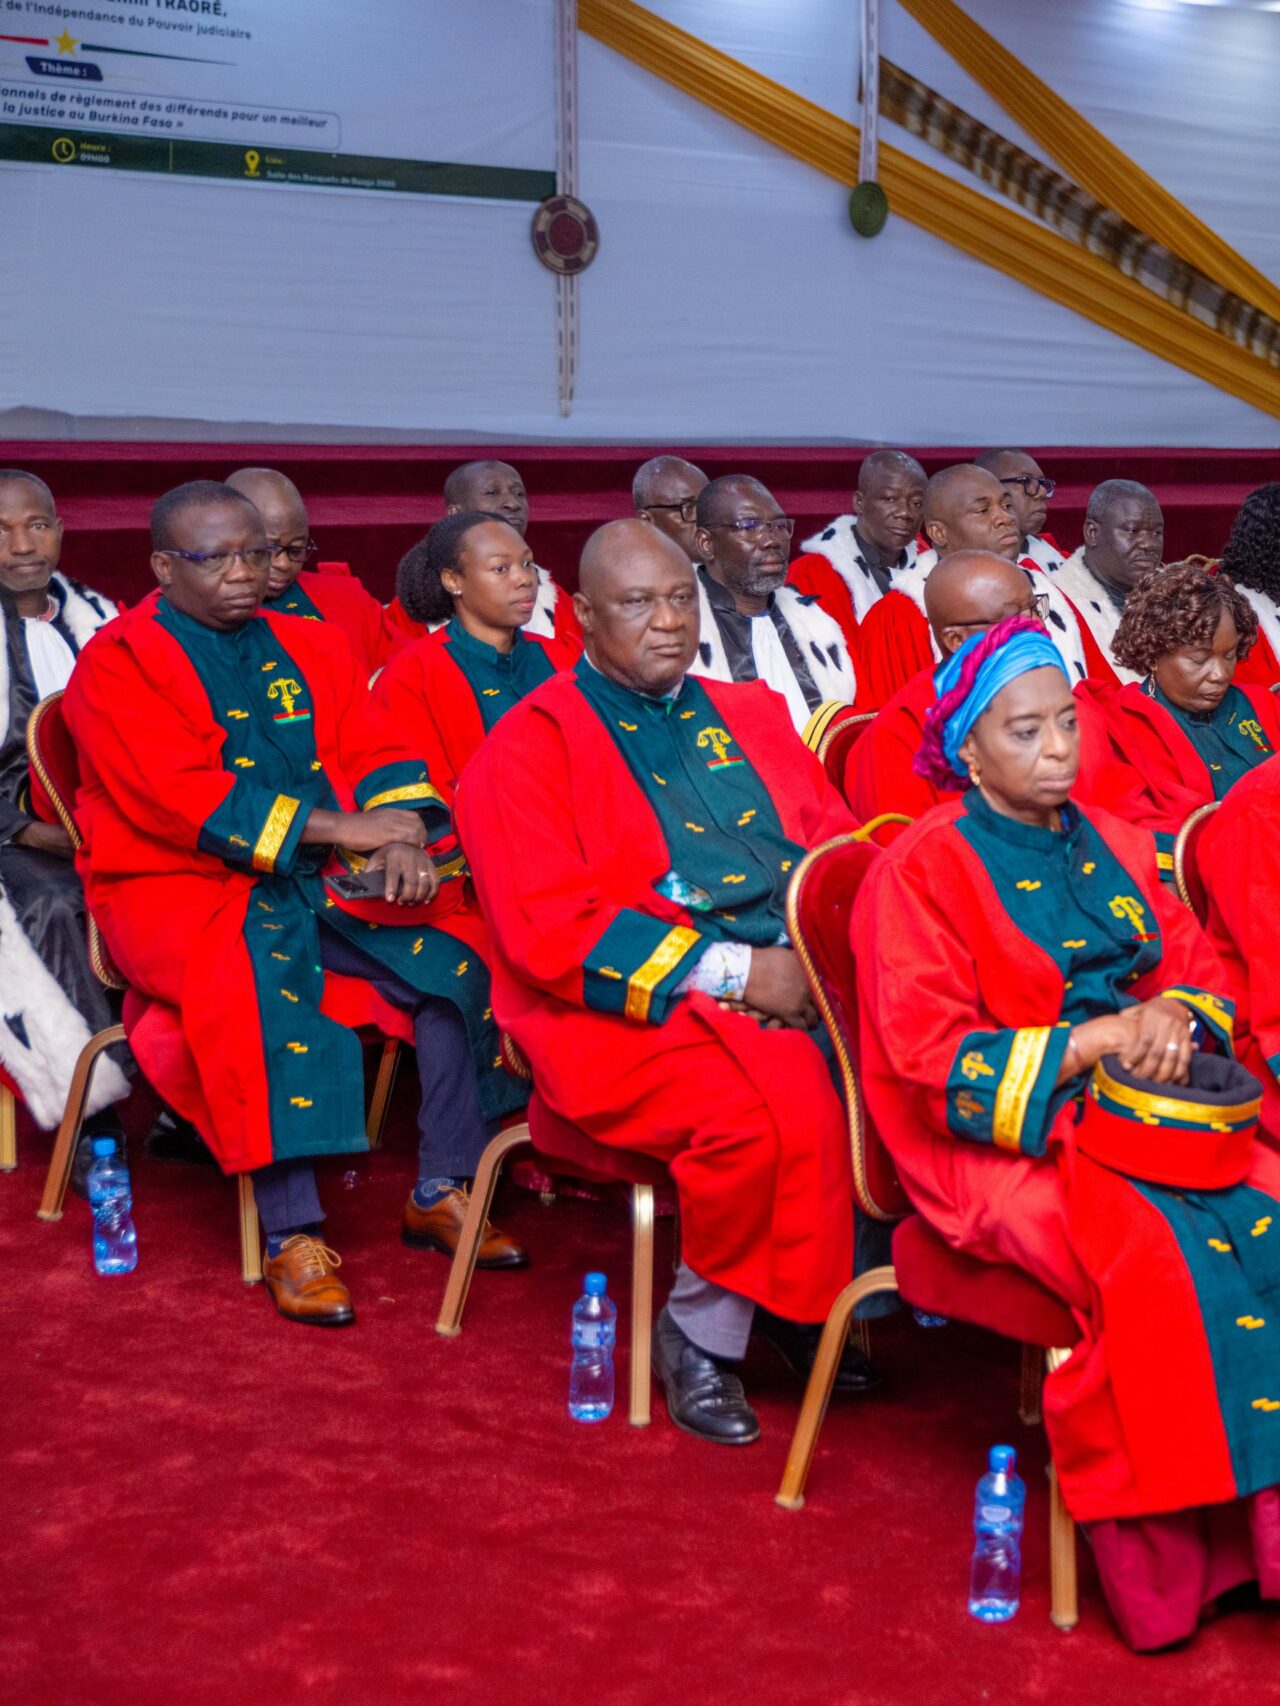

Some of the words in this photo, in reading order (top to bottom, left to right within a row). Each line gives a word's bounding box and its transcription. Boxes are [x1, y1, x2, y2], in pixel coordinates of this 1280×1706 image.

[6, 0, 22, 11] de
[26, 1, 125, 24] l'Indépendance
[128, 15, 144, 26] du
[147, 17, 193, 32] Pouvoir
[196, 23, 252, 40] judiciaire
[40, 61, 81, 76] Thème
[0, 85, 47, 101] onnels
[50, 91, 66, 103] de
[70, 94, 136, 111] règlement
[140, 100, 162, 112] des
[165, 102, 229, 119] différends
[231, 111, 260, 122] pour
[262, 113, 277, 123] un
[280, 115, 328, 128] meilleur
[3, 102, 15, 113] la
[18, 103, 66, 118] justice
[69, 109, 85, 120] au
[89, 110, 139, 126] Burkina
[142, 115, 173, 128] Faso
